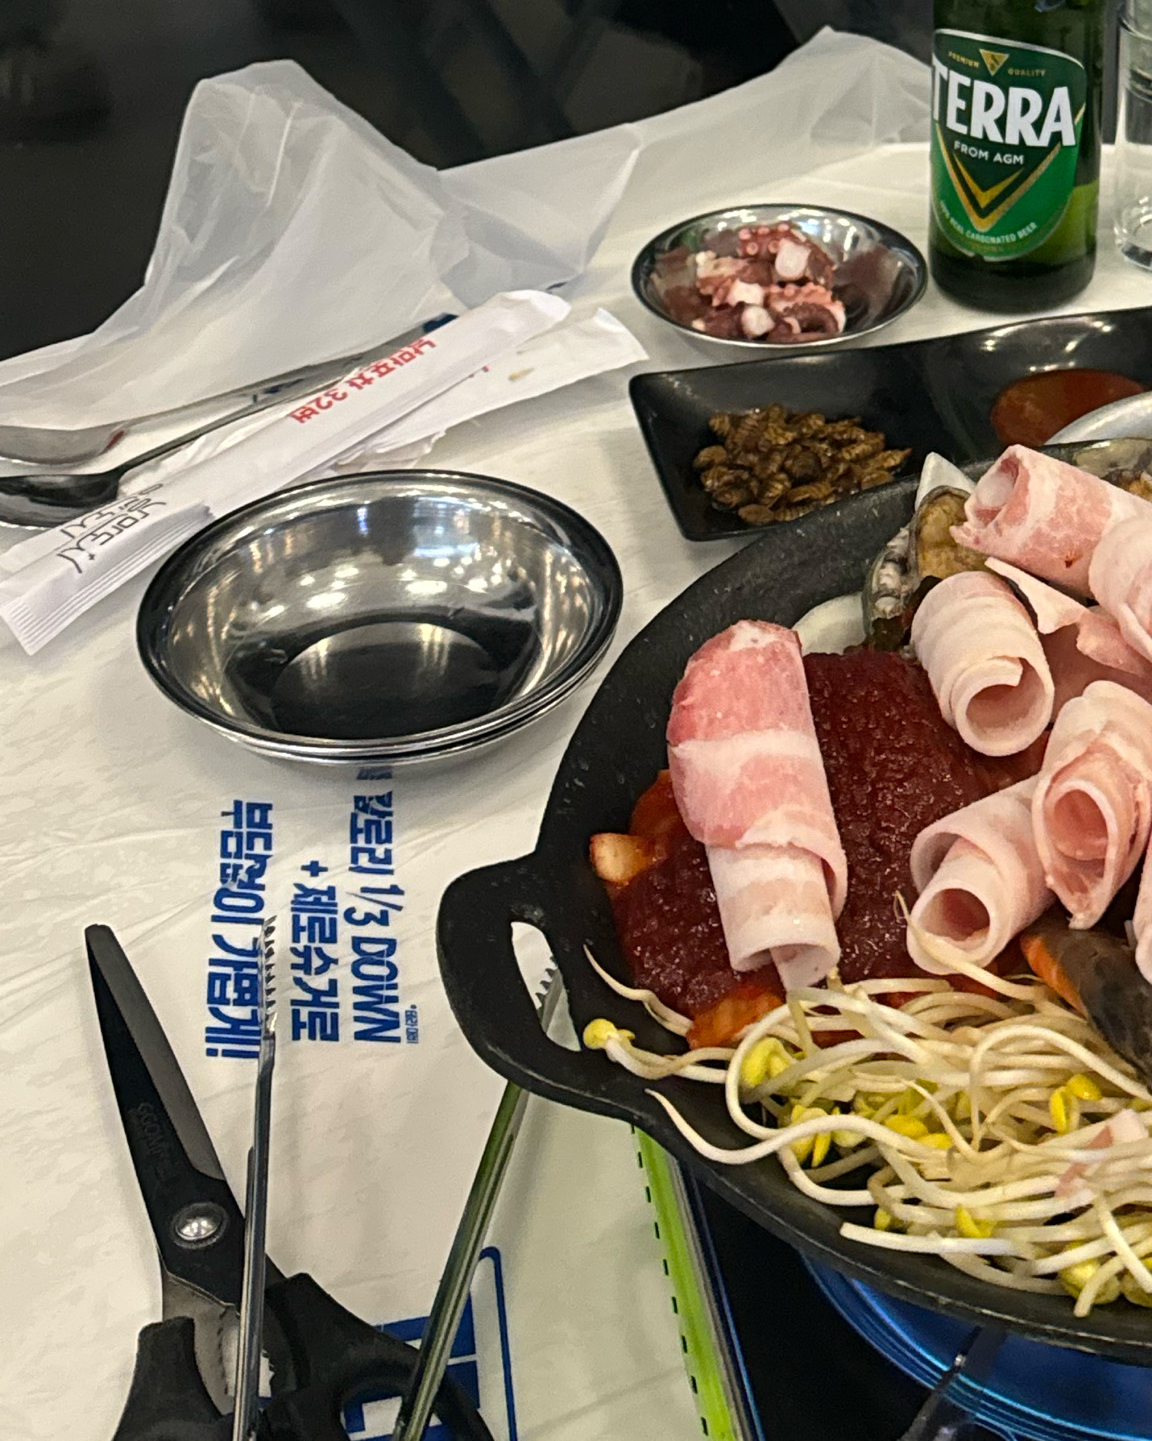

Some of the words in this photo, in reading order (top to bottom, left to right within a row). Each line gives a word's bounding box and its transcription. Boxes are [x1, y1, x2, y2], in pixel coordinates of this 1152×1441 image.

[932, 51, 1076, 148] TERRA
[948, 51, 980, 69] PREMIUM
[1007, 67, 1046, 78] QUALITY
[953, 140, 988, 161] FROM
[993, 152, 1024, 165] AGM
[966, 229, 1016, 244] CARBONATED
[1017, 221, 1038, 239] BEER
[346, 338, 437, 390] 낭만포차
[210, 799, 273, 925] 부담없이
[205, 934, 261, 1059] 가볍게!
[290, 883, 339, 1043] 제로슈거로
[351, 936, 401, 1043] DOWN
